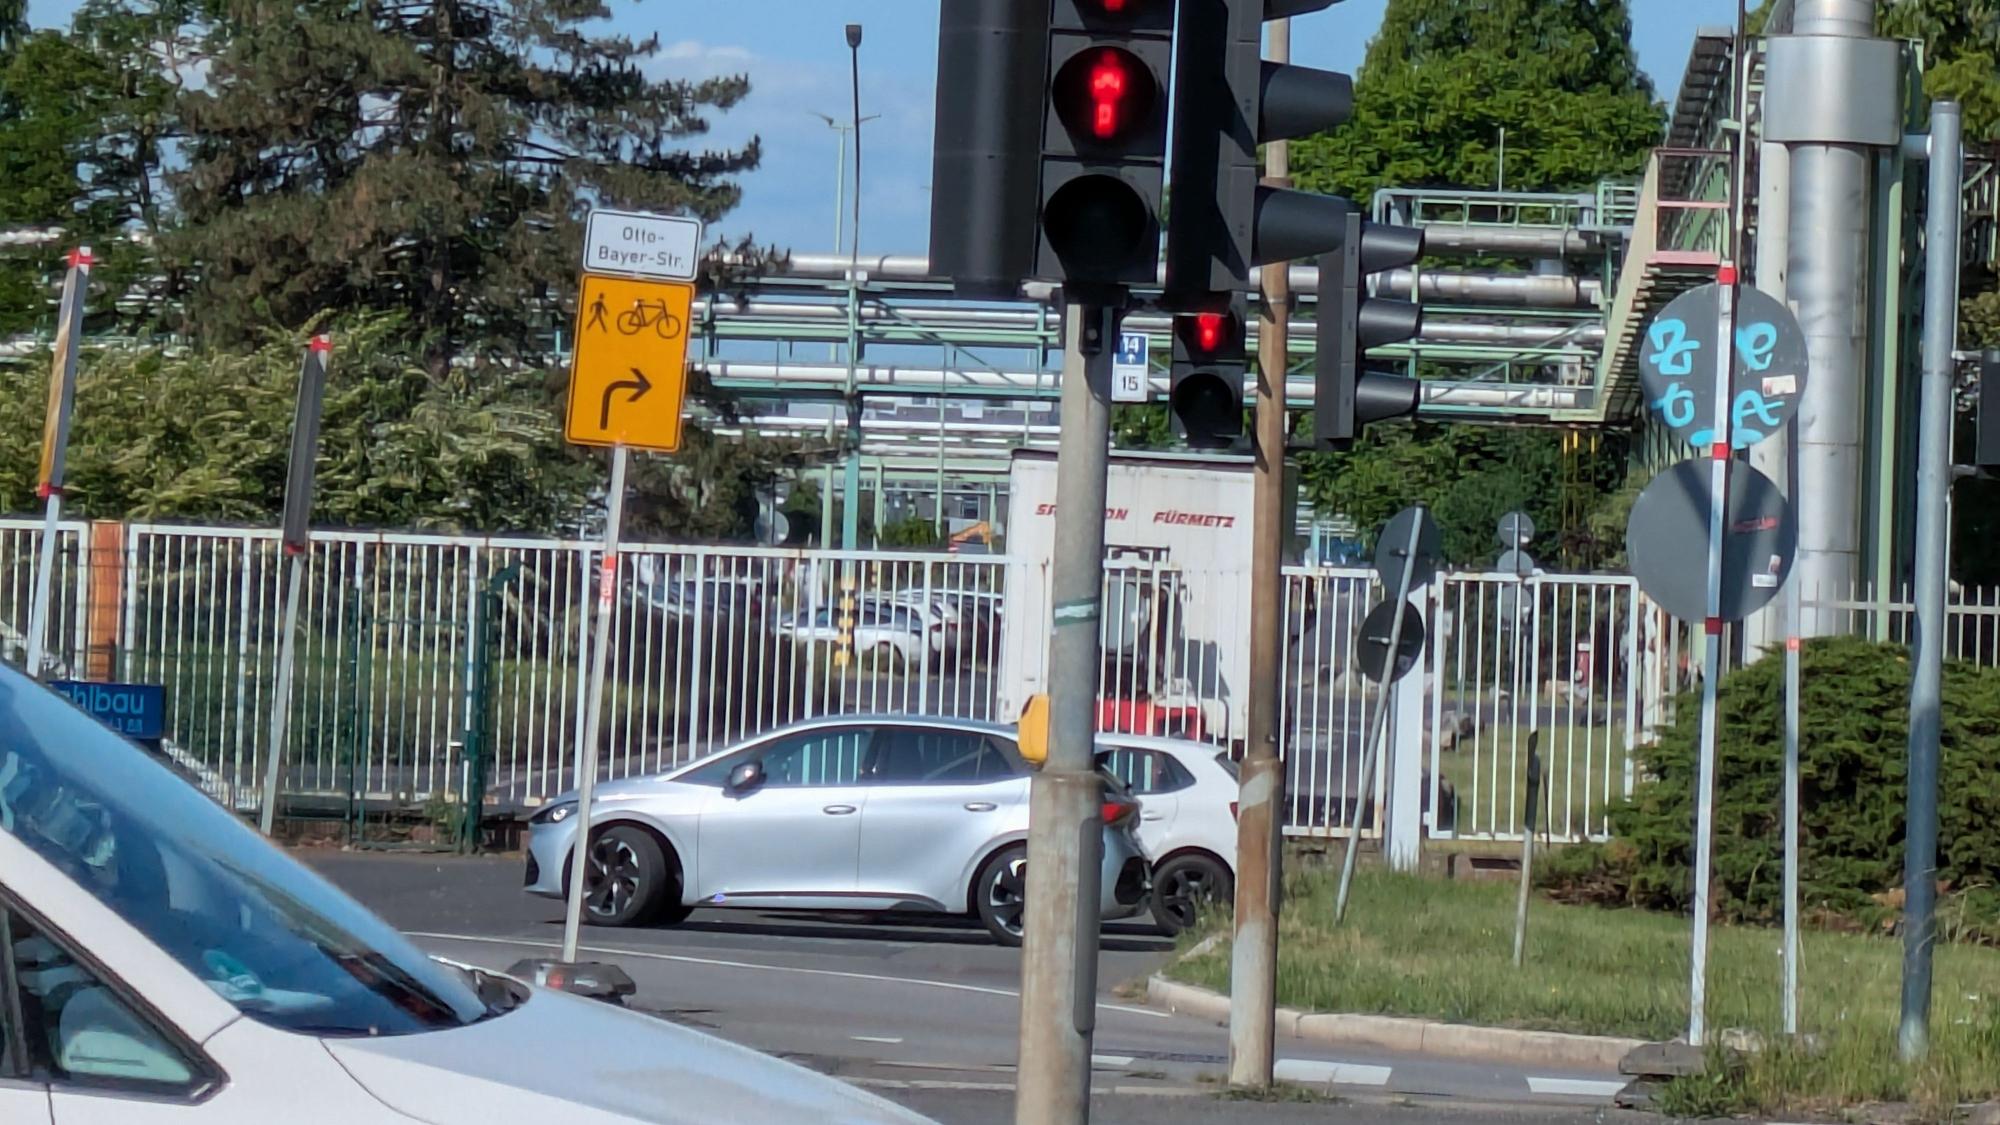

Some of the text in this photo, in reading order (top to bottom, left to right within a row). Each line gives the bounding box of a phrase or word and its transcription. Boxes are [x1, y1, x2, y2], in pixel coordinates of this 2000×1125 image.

[622, 226, 665, 244] Otto-
[598, 245, 685, 268] Bayer-Str.
[1122, 336, 1139, 353] 14
[1122, 375, 1138, 391] 15
[1153, 510, 1235, 528] FÜRMETZ
